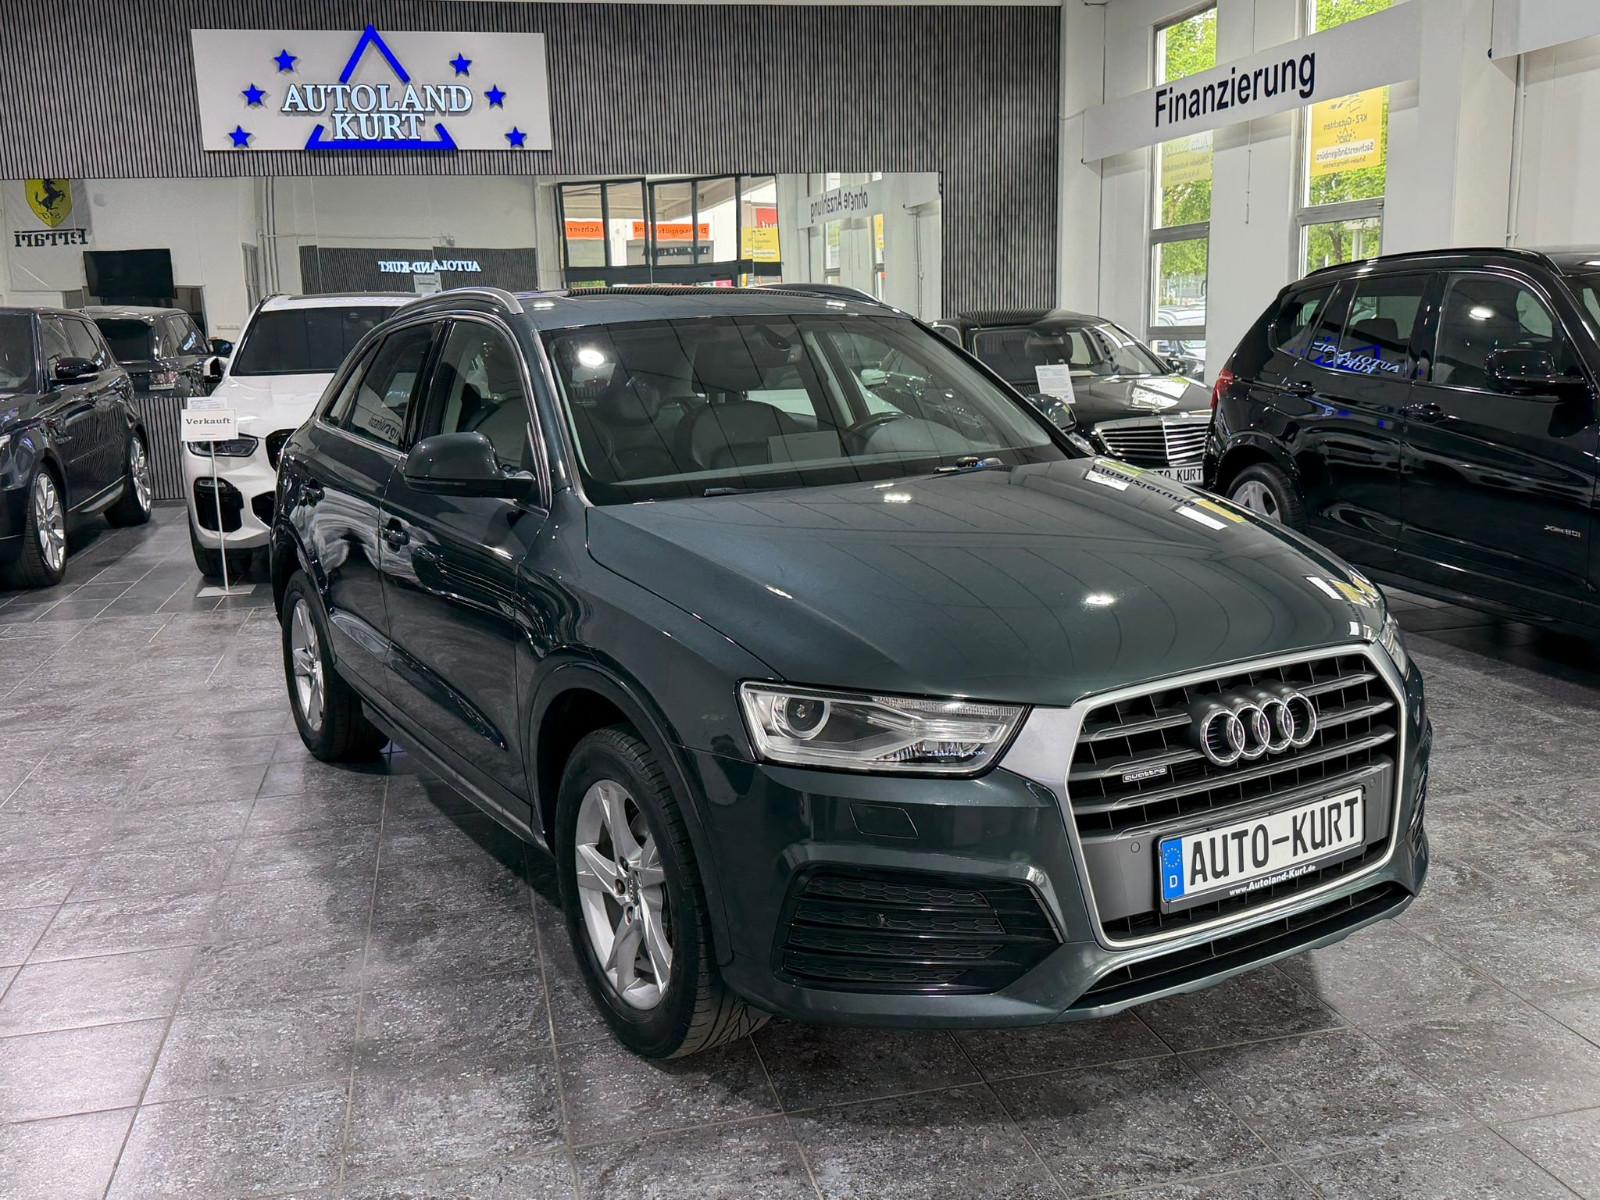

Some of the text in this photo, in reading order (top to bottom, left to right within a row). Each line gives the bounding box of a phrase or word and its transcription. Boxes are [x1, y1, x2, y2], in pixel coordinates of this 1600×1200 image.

[282, 84, 473, 112] AUTOLAND
[1155, 52, 1316, 127] Finanzierung
[332, 113, 425, 140] KURT
[185, 417, 231, 425] Verkauft
[1176, 468, 1203, 482] KURT
[1124, 768, 1166, 781] quattro
[1190, 797, 1358, 886] AUTO-KURT
[1169, 875, 1178, 888] D
[1229, 865, 1316, 896] www.Autoland-Kurt.de
